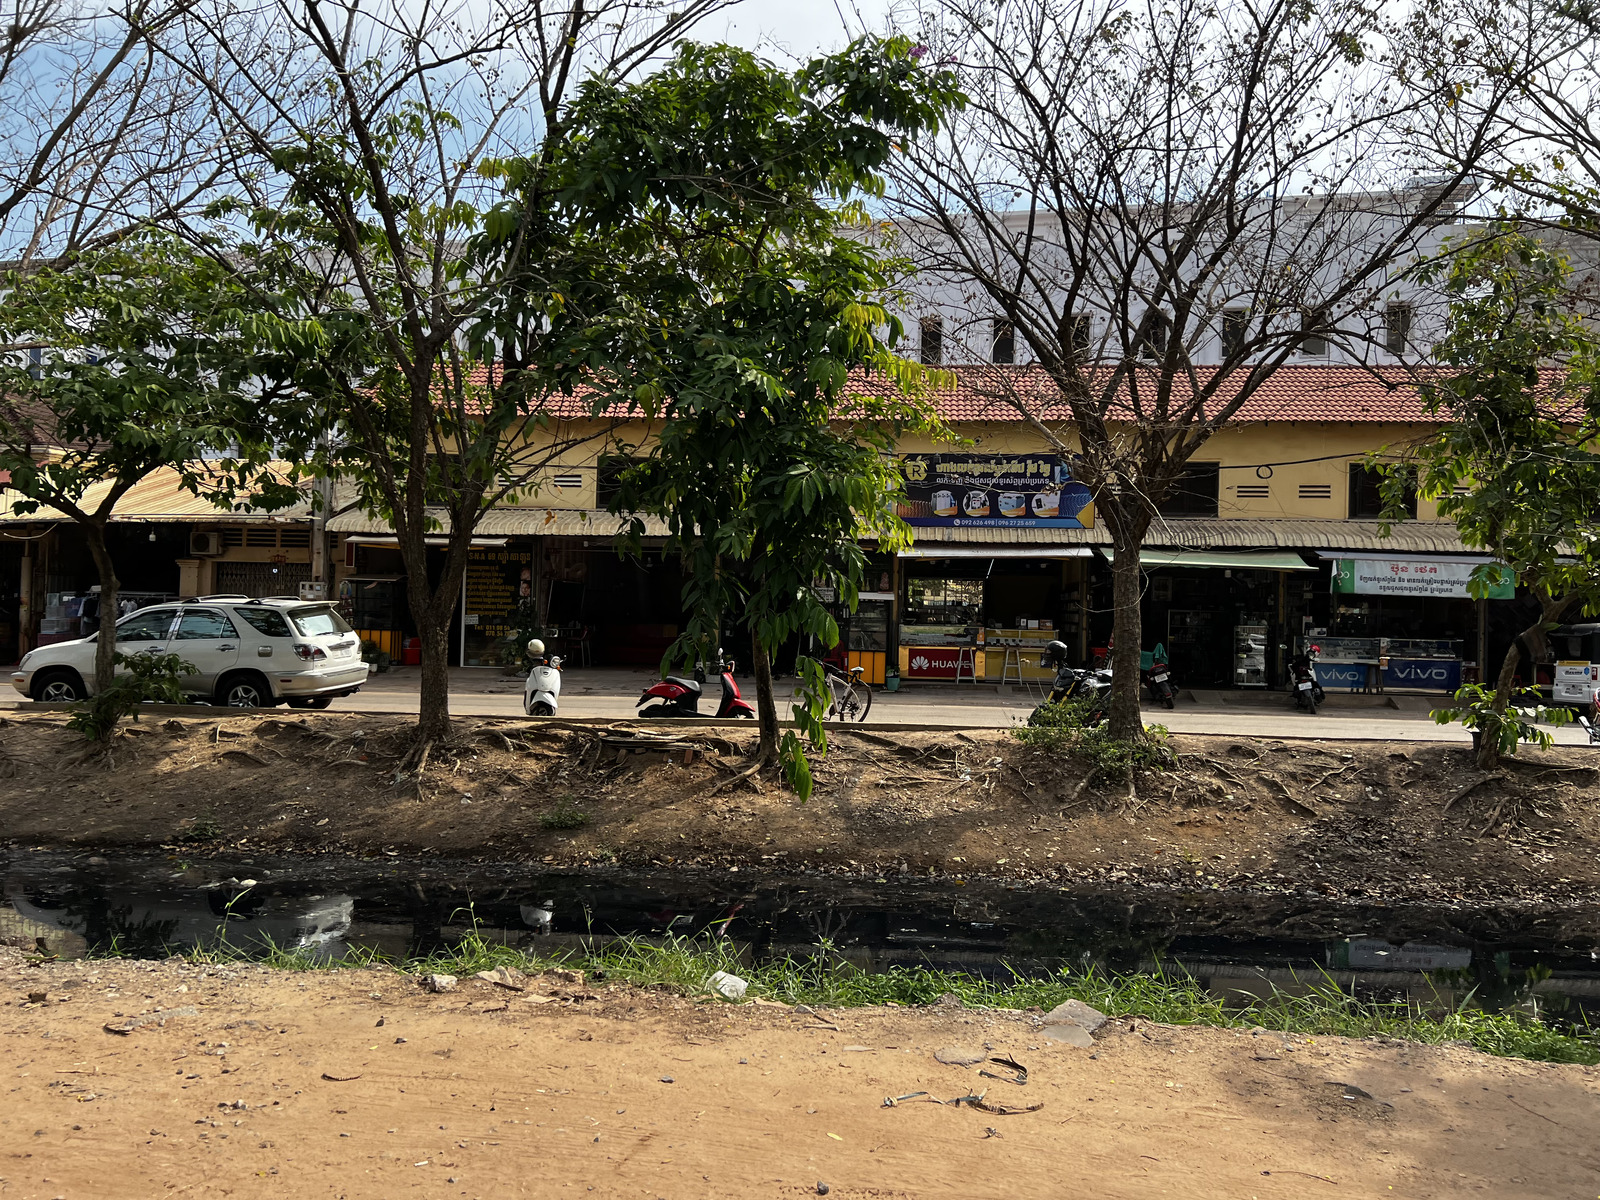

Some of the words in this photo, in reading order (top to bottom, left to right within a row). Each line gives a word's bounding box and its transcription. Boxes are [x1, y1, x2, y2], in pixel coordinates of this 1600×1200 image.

[912, 465, 922, 477] R
[1320, 669, 1359, 680] vivo
[1394, 665, 1447, 680] vivo
